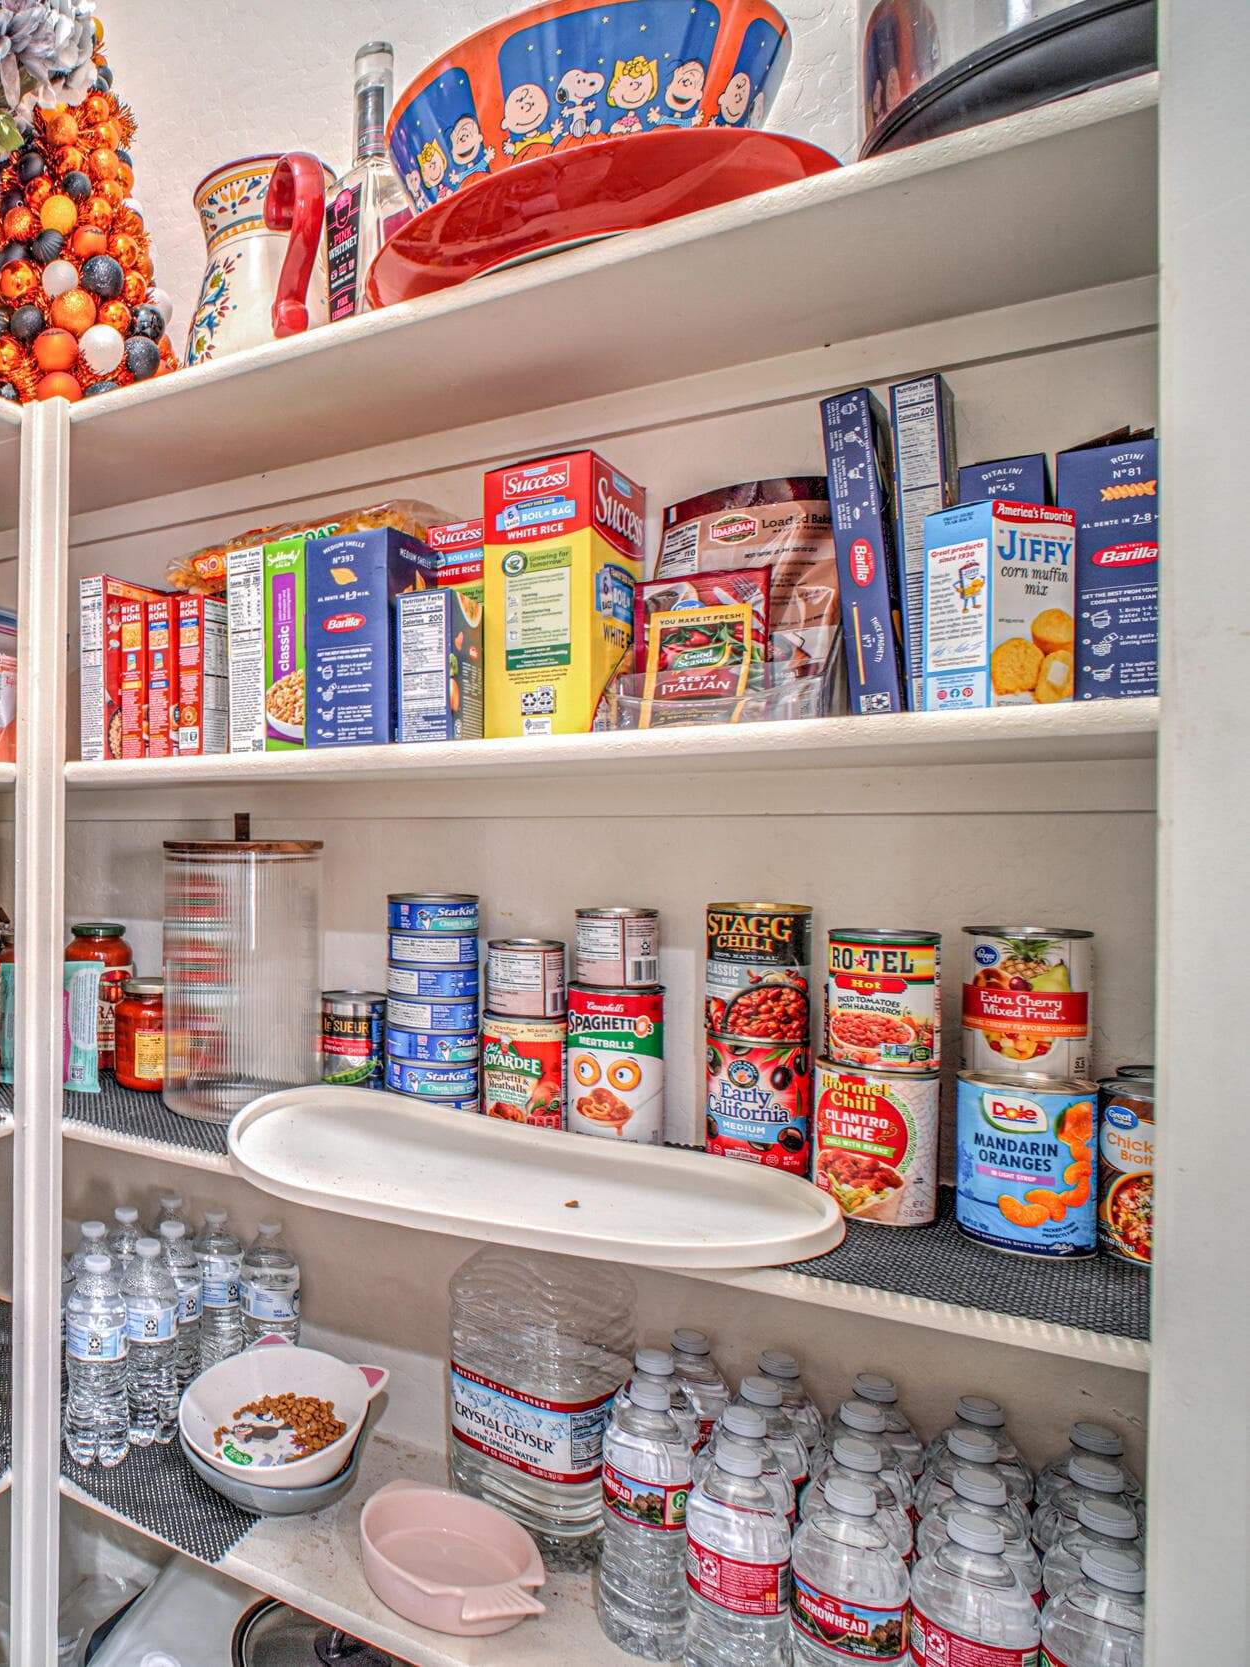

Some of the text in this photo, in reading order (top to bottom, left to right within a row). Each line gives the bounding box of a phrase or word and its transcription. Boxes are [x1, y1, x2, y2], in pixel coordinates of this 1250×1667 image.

[333, 226, 353, 247] PINK
[328, 234, 359, 260] WHITNEY
[920, 381, 933, 389] Facts
[920, 406, 934, 416] 200
[1110, 453, 1145, 465] ROTINI
[981, 468, 1023, 481] DITALINI
[505, 472, 567, 496] Success
[508, 510, 514, 519] 6
[522, 505, 572, 521] BOIL BAG
[595, 477, 644, 547] Success
[997, 503, 1073, 523] America's Favorite
[433, 528, 482, 546] Success
[507, 522, 564, 540] WHITE RICE
[713, 522, 755, 537] IDAHOAN
[323, 542, 344, 554] MEDIUM
[997, 529, 1072, 565] JIFFY
[855, 545, 869, 582] Barilla
[1101, 547, 1159, 564] Barilla
[199, 560, 219, 575] NO
[461, 564, 481, 574] RICE
[1001, 565, 1068, 582] corn muffin
[1024, 581, 1049, 596] mix
[121, 604, 141, 613] RICE
[148, 602, 168, 611] RICE
[179, 599, 198, 608] RICE
[327, 617, 361, 630] Barilla
[428, 614, 444, 623] 200
[660, 618, 676, 626] YOU
[678, 616, 701, 624] MAKE
[278, 625, 290, 672] classic
[684, 650, 713, 660] Good
[678, 657, 719, 668] Seasons
[677, 674, 718, 683] ZESTY
[661, 680, 731, 696] ITALIAN
[437, 906, 476, 917] StarKist
[707, 913, 794, 942] STAGG
[717, 935, 773, 953] CHILI
[851, 979, 882, 990] Hot
[586, 1001, 625, 1013] Campbell's
[856, 997, 901, 1008] TOMATOES
[980, 991, 1062, 1011] Extra Cherry
[854, 1003, 901, 1016] HABANEROS
[983, 1003, 1059, 1020] Mixed Fruit
[334, 1020, 370, 1035] SUEUR
[485, 1042, 499, 1053] Chef
[578, 1036, 635, 1049] MEATBALLS
[483, 1052, 541, 1076] BOYARDEE
[425, 1071, 468, 1082] StarKist
[487, 1071, 523, 1086] Spaghetti
[488, 1080, 527, 1094] Meatballs
[822, 1072, 891, 1098] Hormel
[720, 1082, 771, 1109] Early
[830, 1091, 877, 1112] Chili
[709, 1094, 789, 1123] California
[992, 1101, 1038, 1121] Dole
[1109, 1109, 1132, 1121] Great
[722, 1120, 766, 1134] MEDIUM
[825, 1109, 889, 1129] CILANTRO
[831, 1122, 875, 1142] LIME
[973, 1132, 1059, 1157] MANDARIN
[1106, 1132, 1154, 1153] Chick
[978, 1149, 1052, 1172] ORANGES
[998, 1172, 1037, 1183] LIGHT SYRUP
[488, 1382, 497, 1390] AT
[519, 1394, 551, 1410] SOURCE
[455, 1401, 556, 1455] CRYSTAL GEYSER
[466, 1427, 488, 1443] ALPINE
[488, 1437, 514, 1454] SPRING
[484, 1428, 517, 1447] NATURAL
[800, 1595, 867, 1634] ARROWHEAD
